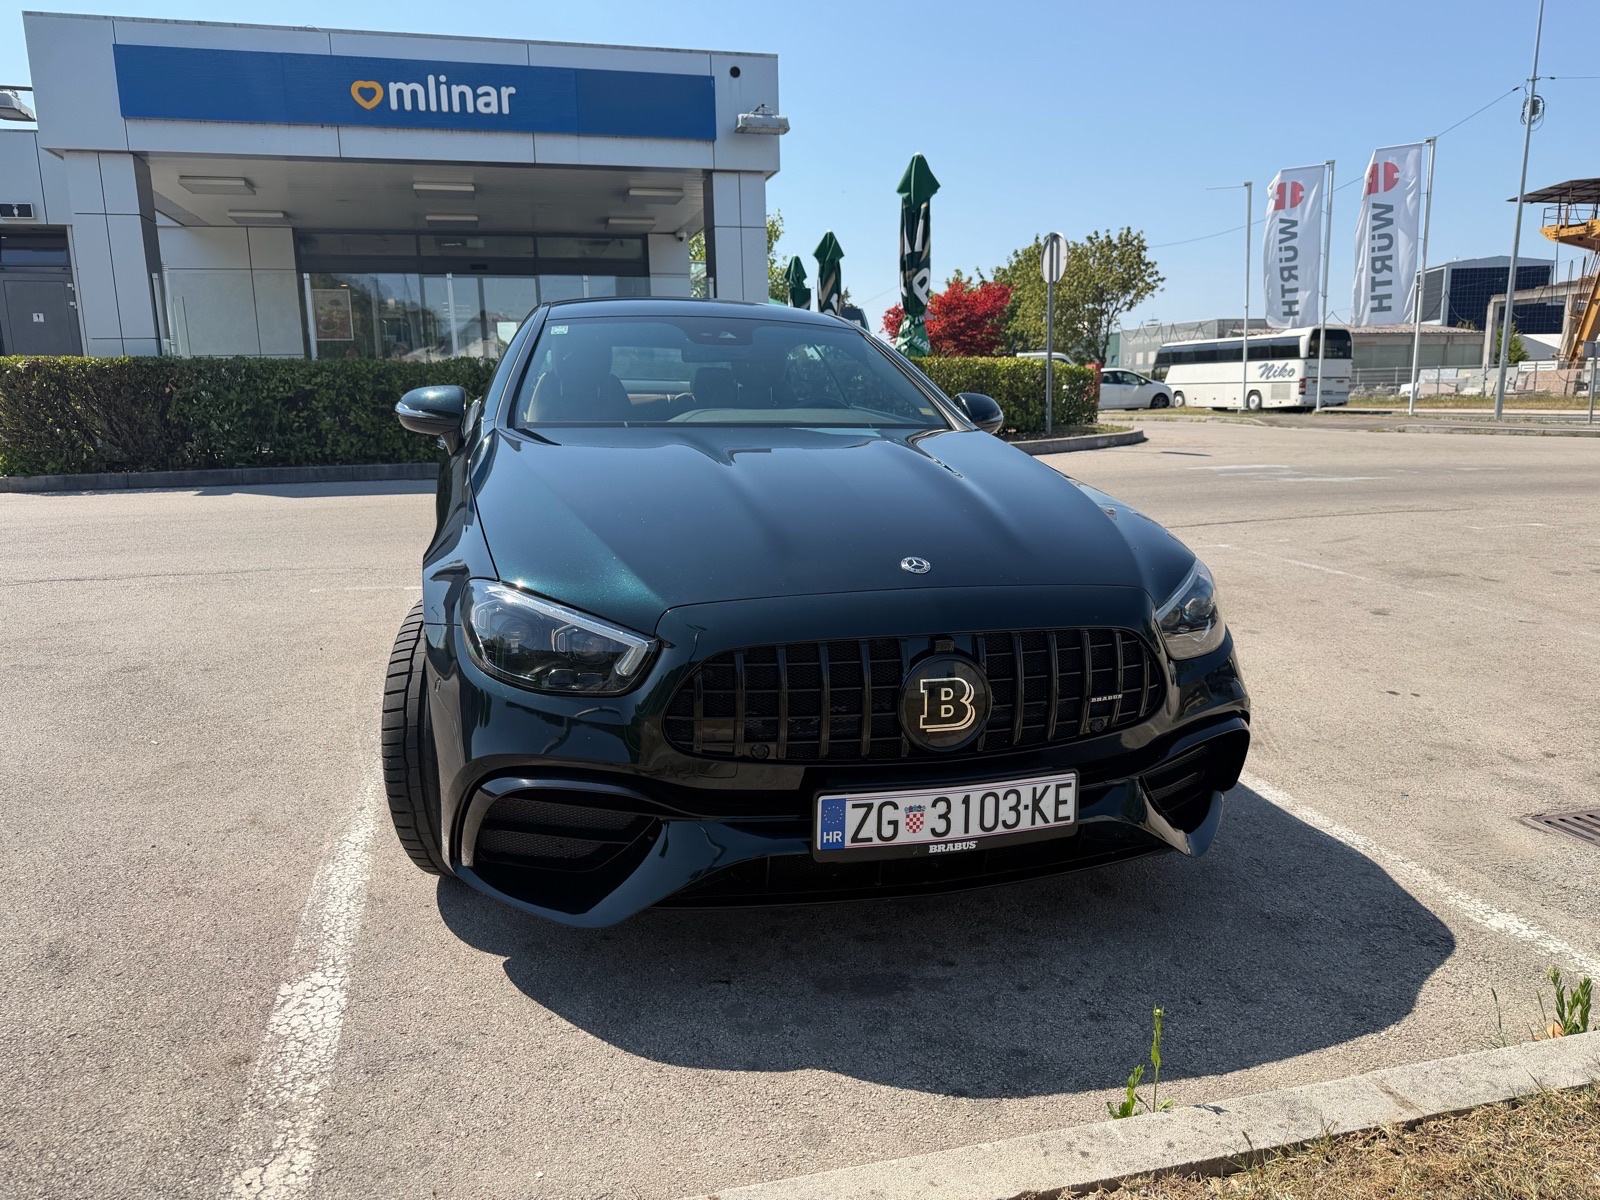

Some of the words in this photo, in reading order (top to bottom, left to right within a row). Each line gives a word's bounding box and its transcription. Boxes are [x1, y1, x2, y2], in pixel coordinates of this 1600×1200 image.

[388, 74, 516, 114] mlinar
[1258, 362, 1296, 380] Niko
[1090, 694, 1123, 703] BRABUS
[850, 801, 899, 844] ZG
[823, 831, 842, 843] HR
[929, 840, 977, 854] BRABUS
